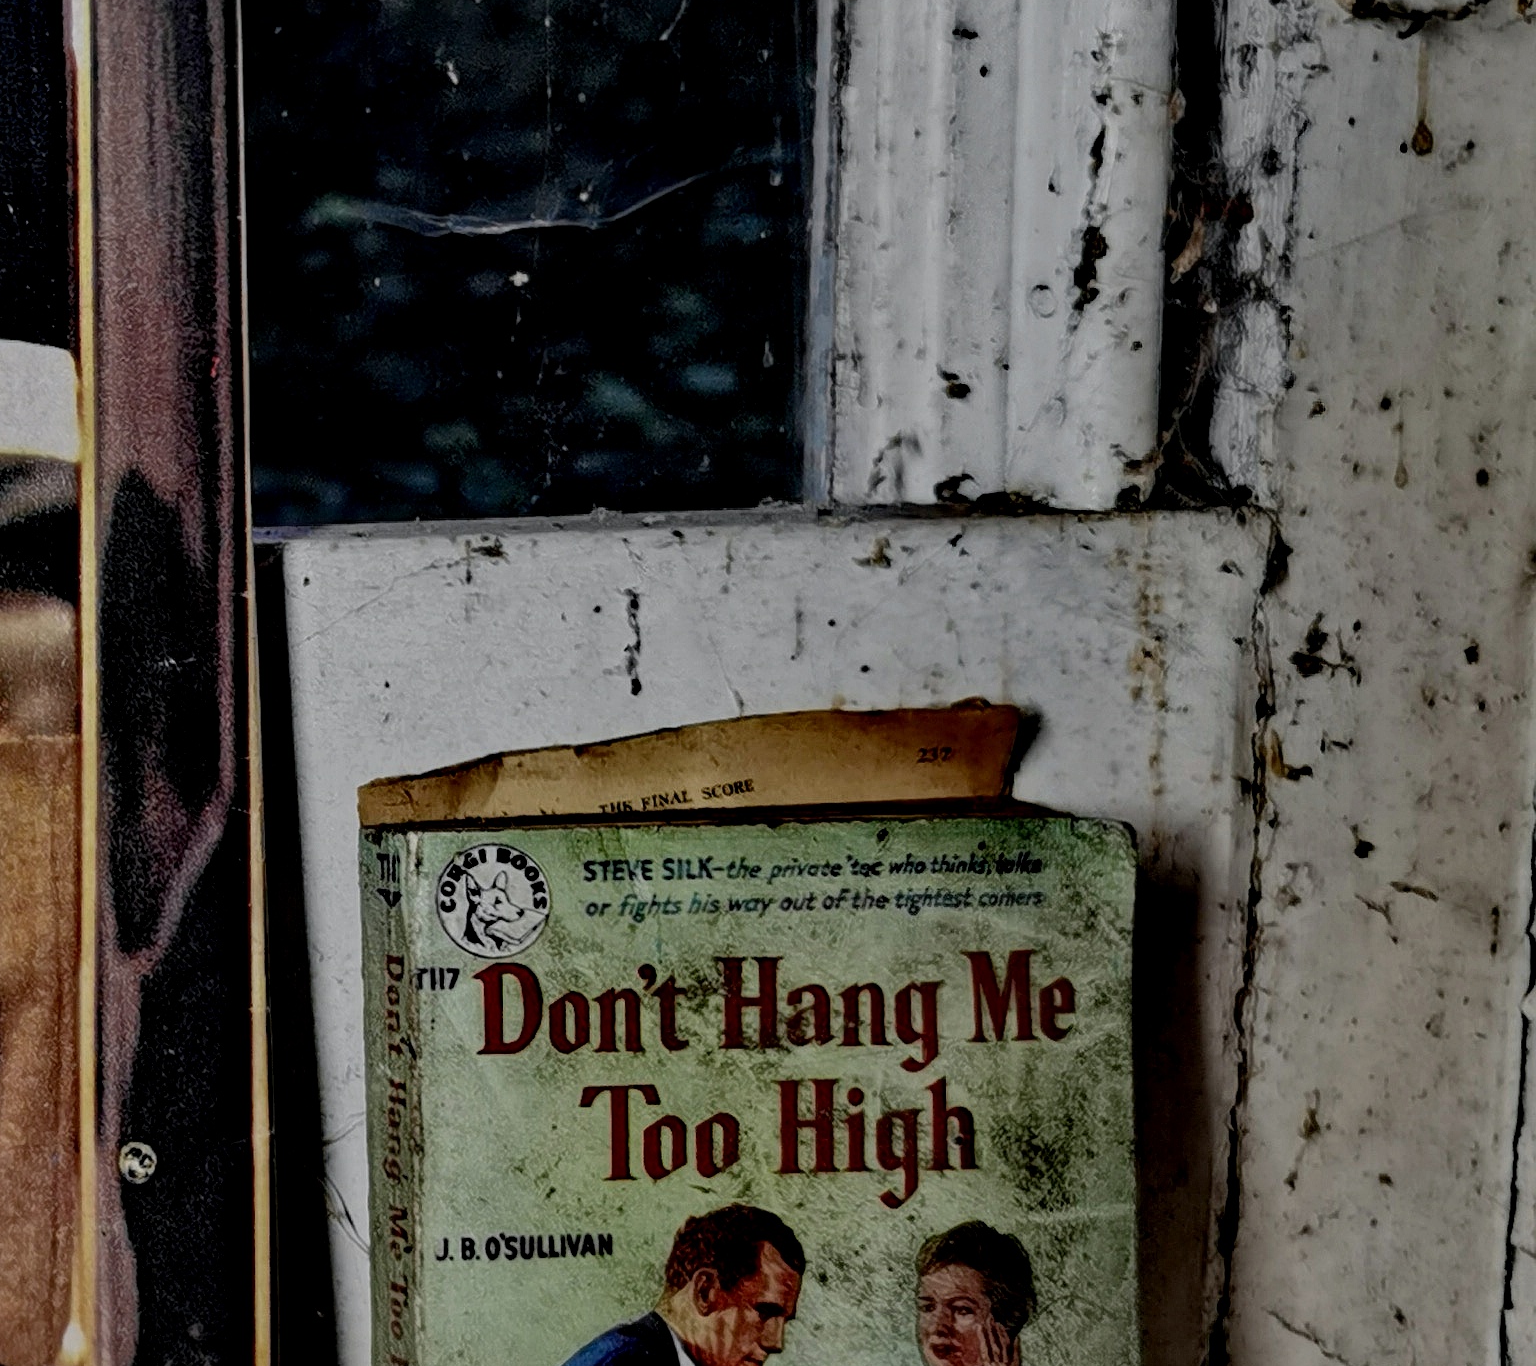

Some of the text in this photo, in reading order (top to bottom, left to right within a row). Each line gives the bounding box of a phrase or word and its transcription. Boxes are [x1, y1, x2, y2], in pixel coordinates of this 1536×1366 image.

[640, 789, 693, 812] FINAL
[701, 778, 755, 801] SCORE
[440, 847, 548, 913] CORGI BOOKS
[583, 858, 653, 882] STEVE
[767, 857, 842, 884] private
[890, 852, 926, 874] who
[585, 900, 611, 918] or
[619, 893, 682, 923] fights
[688, 891, 720, 914] his
[728, 894, 774, 918] way
[780, 892, 816, 911] out
[822, 887, 850, 910] of
[851, 887, 890, 909] the
[894, 886, 972, 916] tightest
[416, 967, 460, 991] T117
[472, 949, 1077, 1072] Don't Hang Me
[383, 1079, 407, 1185] Hang
[578, 1076, 980, 1209] Too High
[388, 1204, 409, 1262] Me
[435, 1232, 614, 1262] J. B. O'SULLIVAN
[390, 1275, 409, 1341] Too
